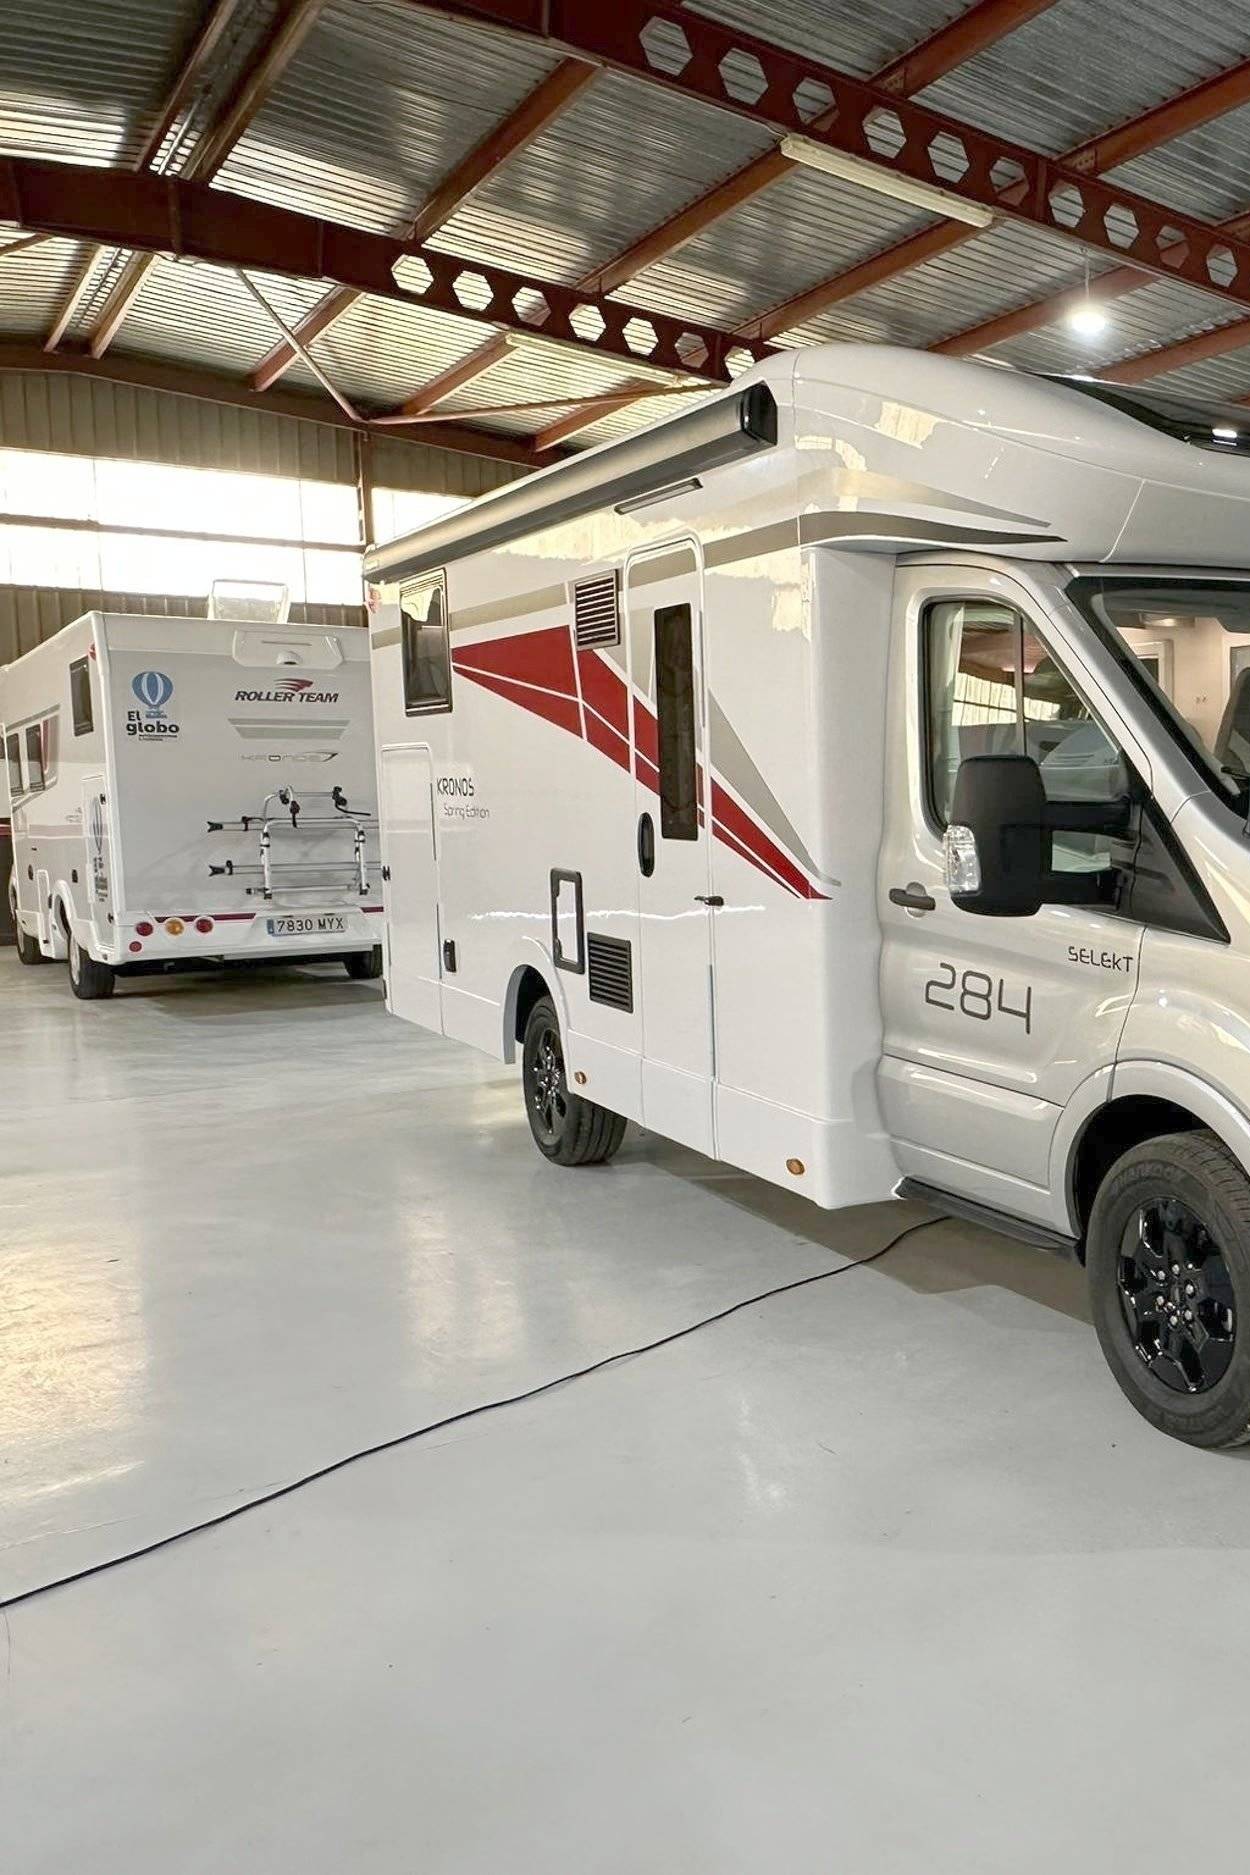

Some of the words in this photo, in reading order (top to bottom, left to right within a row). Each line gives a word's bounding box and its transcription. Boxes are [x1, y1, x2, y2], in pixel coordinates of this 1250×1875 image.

[234, 691, 295, 703] ROLLER
[298, 692, 340, 703] TEAM
[128, 710, 141, 722] El
[126, 721, 180, 736] globo
[436, 777, 475, 797] KRONOS
[277, 918, 313, 933] 7830
[317, 917, 344, 931] MYX
[1067, 945, 1134, 973] SELEKT
[924, 961, 1032, 1035] 284
